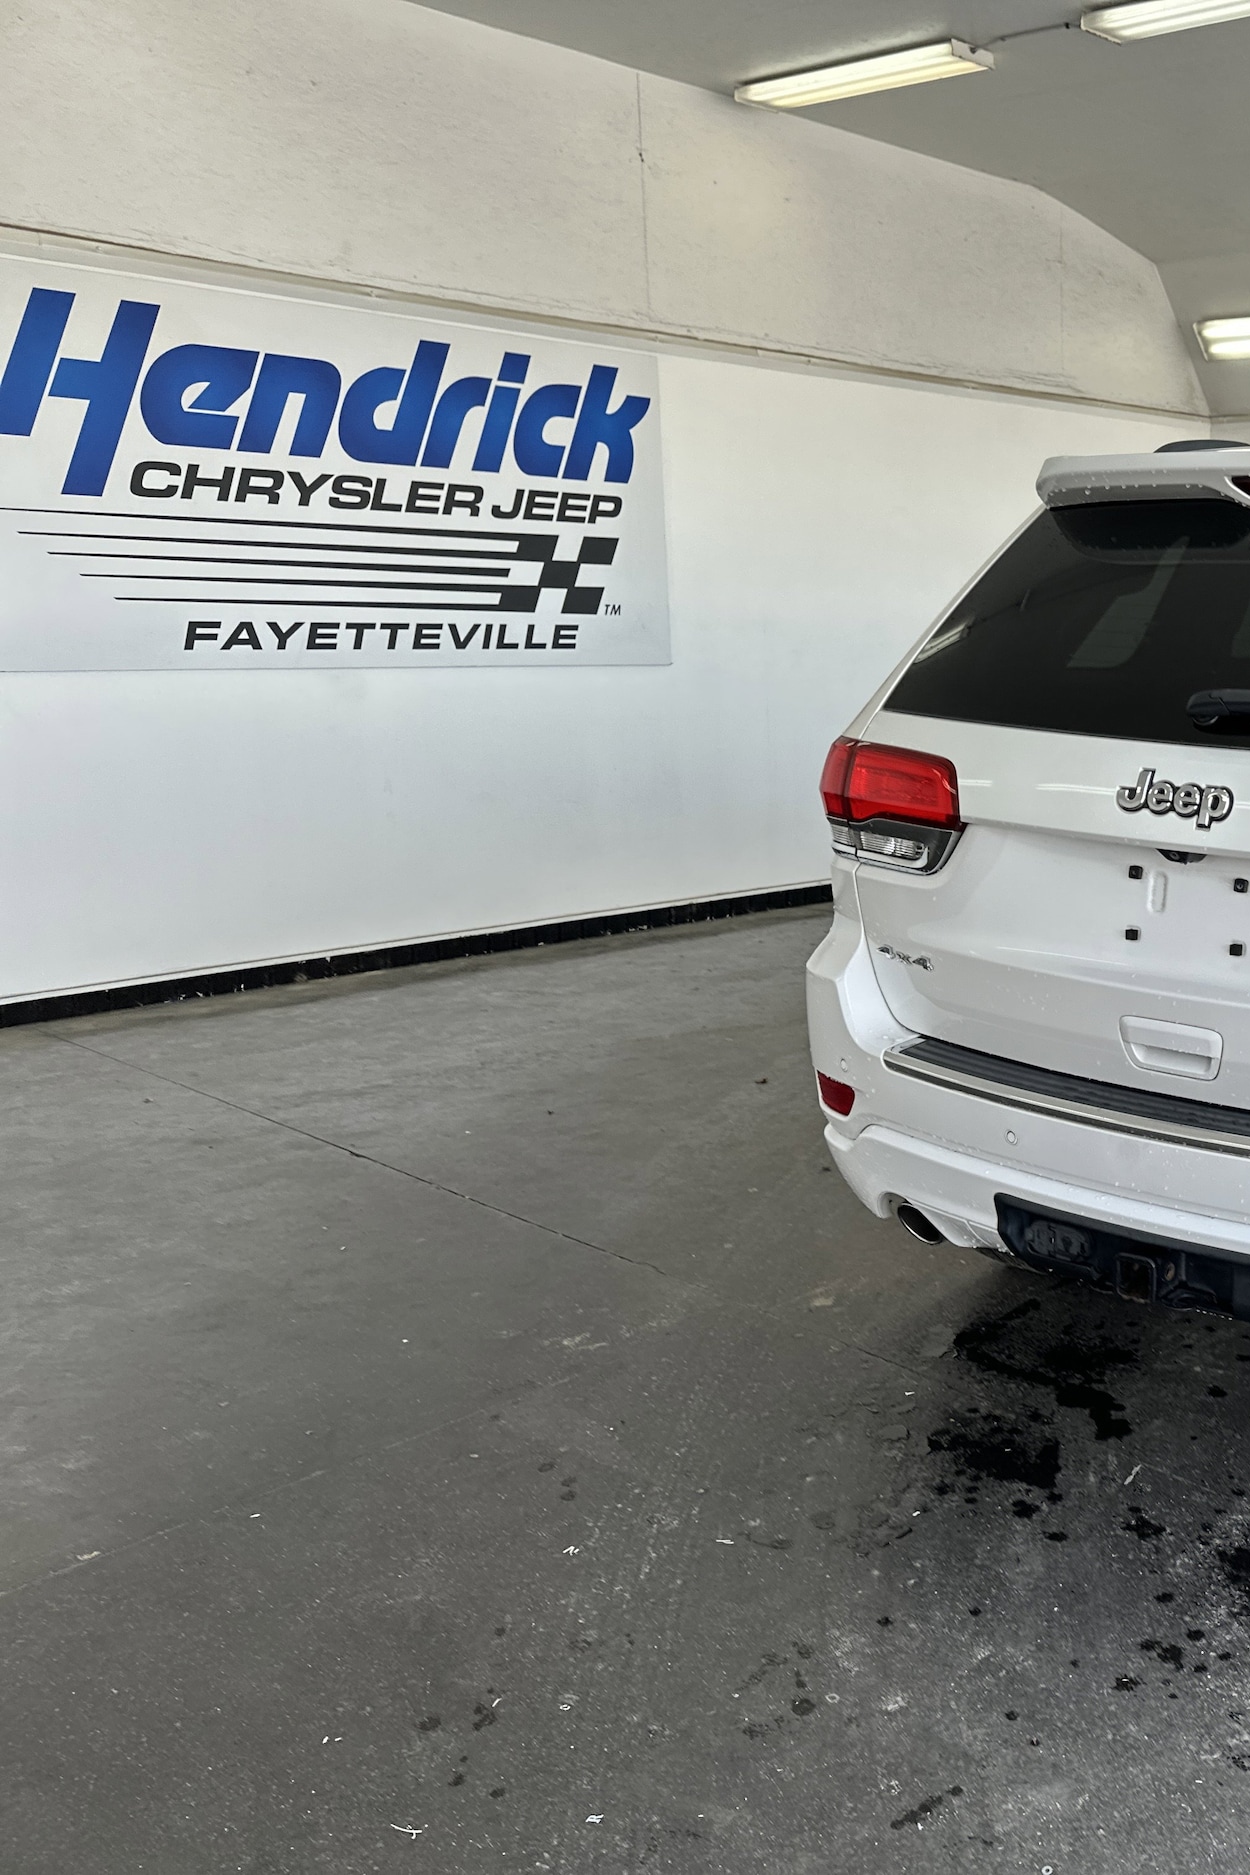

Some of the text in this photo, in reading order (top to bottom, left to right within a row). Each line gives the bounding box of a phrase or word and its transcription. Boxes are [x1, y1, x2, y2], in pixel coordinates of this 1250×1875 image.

[0, 287, 650, 496] Hendrick
[129, 460, 622, 524] CHRYSLER JEEP
[183, 621, 579, 650] FAYETTEVILLE
[604, 604, 621, 616] TM
[1116, 767, 1234, 830] Jeep
